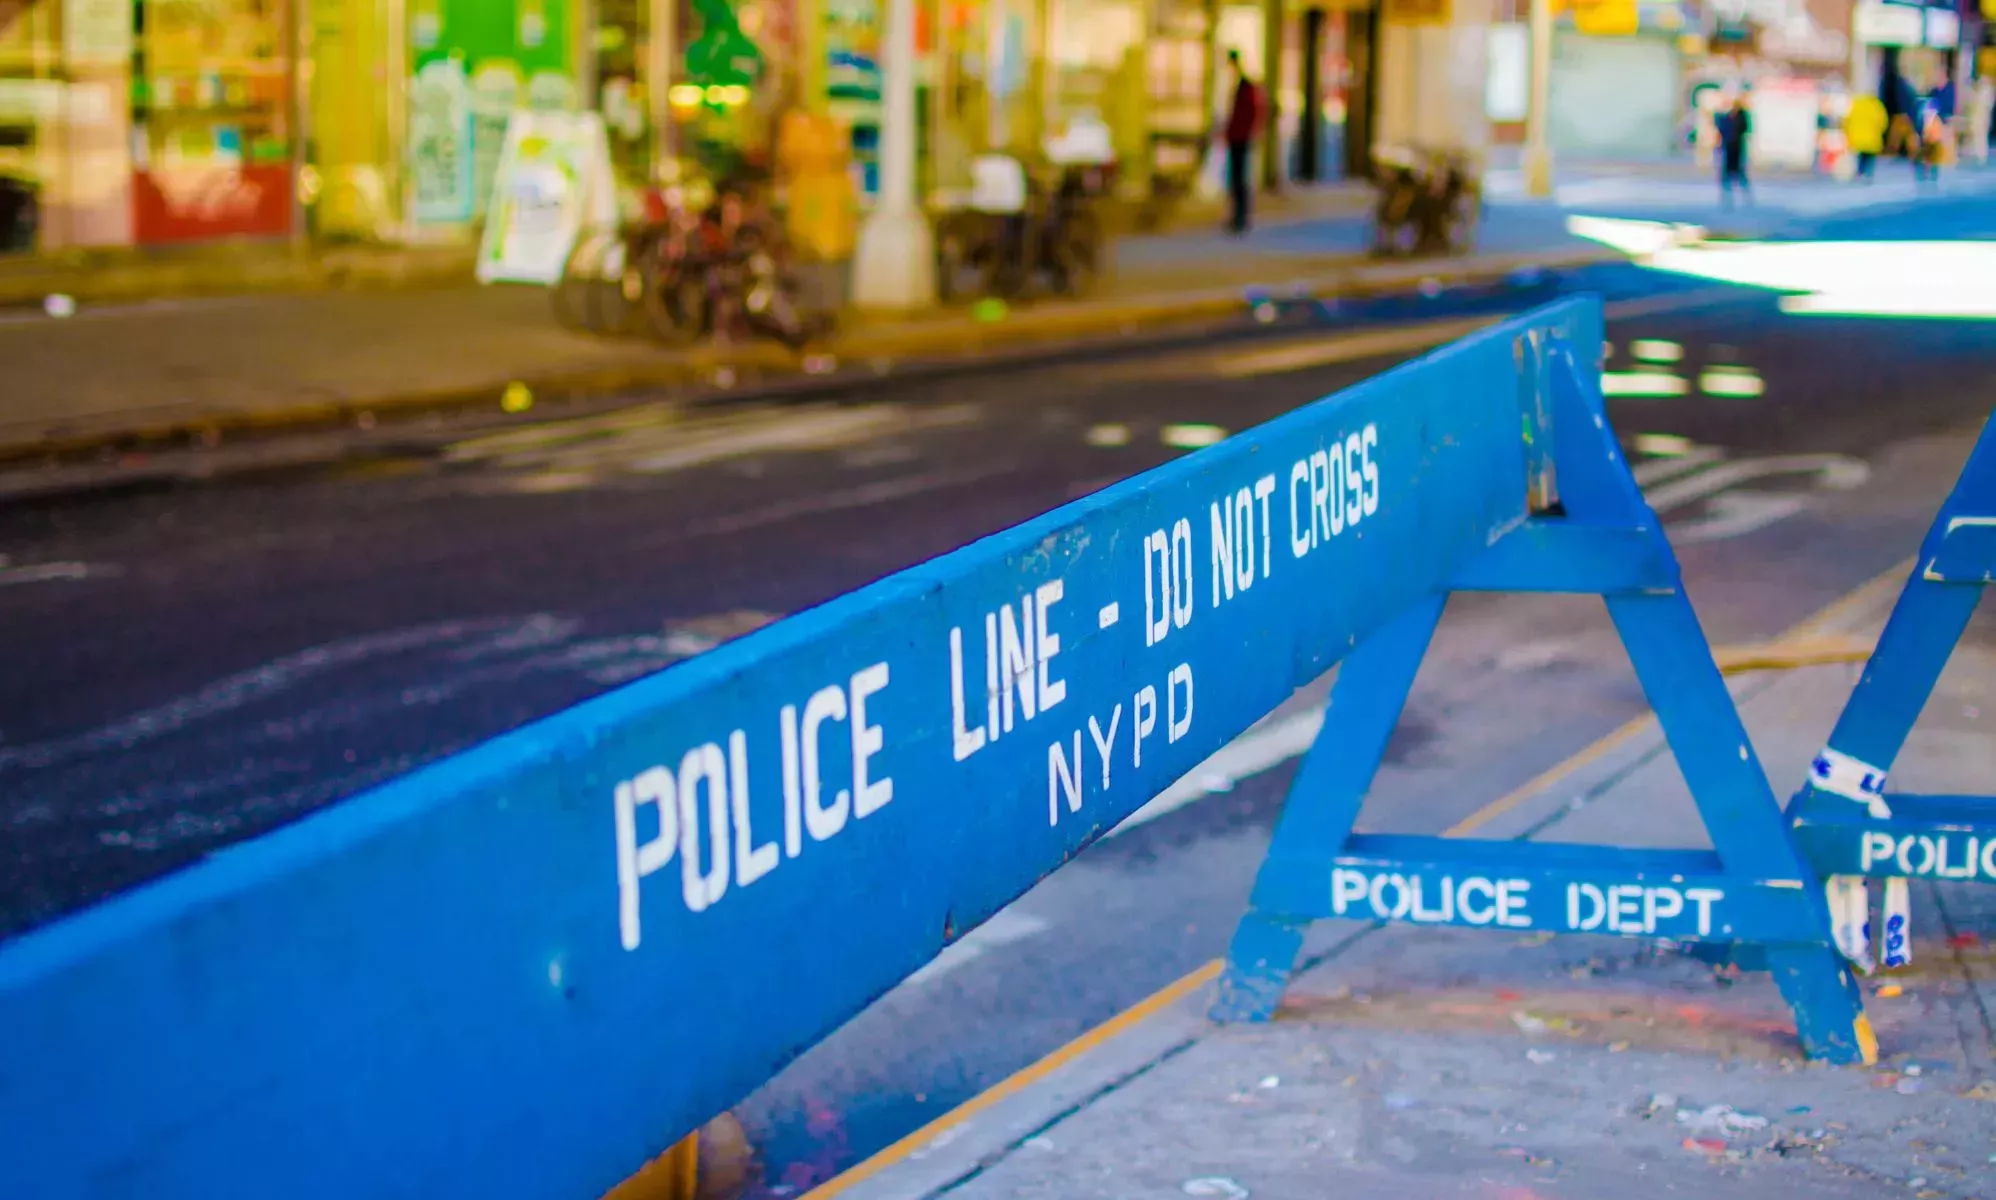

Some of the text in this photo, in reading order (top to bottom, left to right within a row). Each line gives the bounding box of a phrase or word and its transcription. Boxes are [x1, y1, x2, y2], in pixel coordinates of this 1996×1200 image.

[615, 663, 892, 950] POLICE
[951, 579, 1067, 762] LINE
[1144, 518, 1192, 647] DO
[1211, 474, 1275, 608] NOT
[1290, 423, 1378, 558] CROSS
[1049, 663, 1194, 826] NYPD
[1332, 868, 1731, 936] POLICE DEPT.
